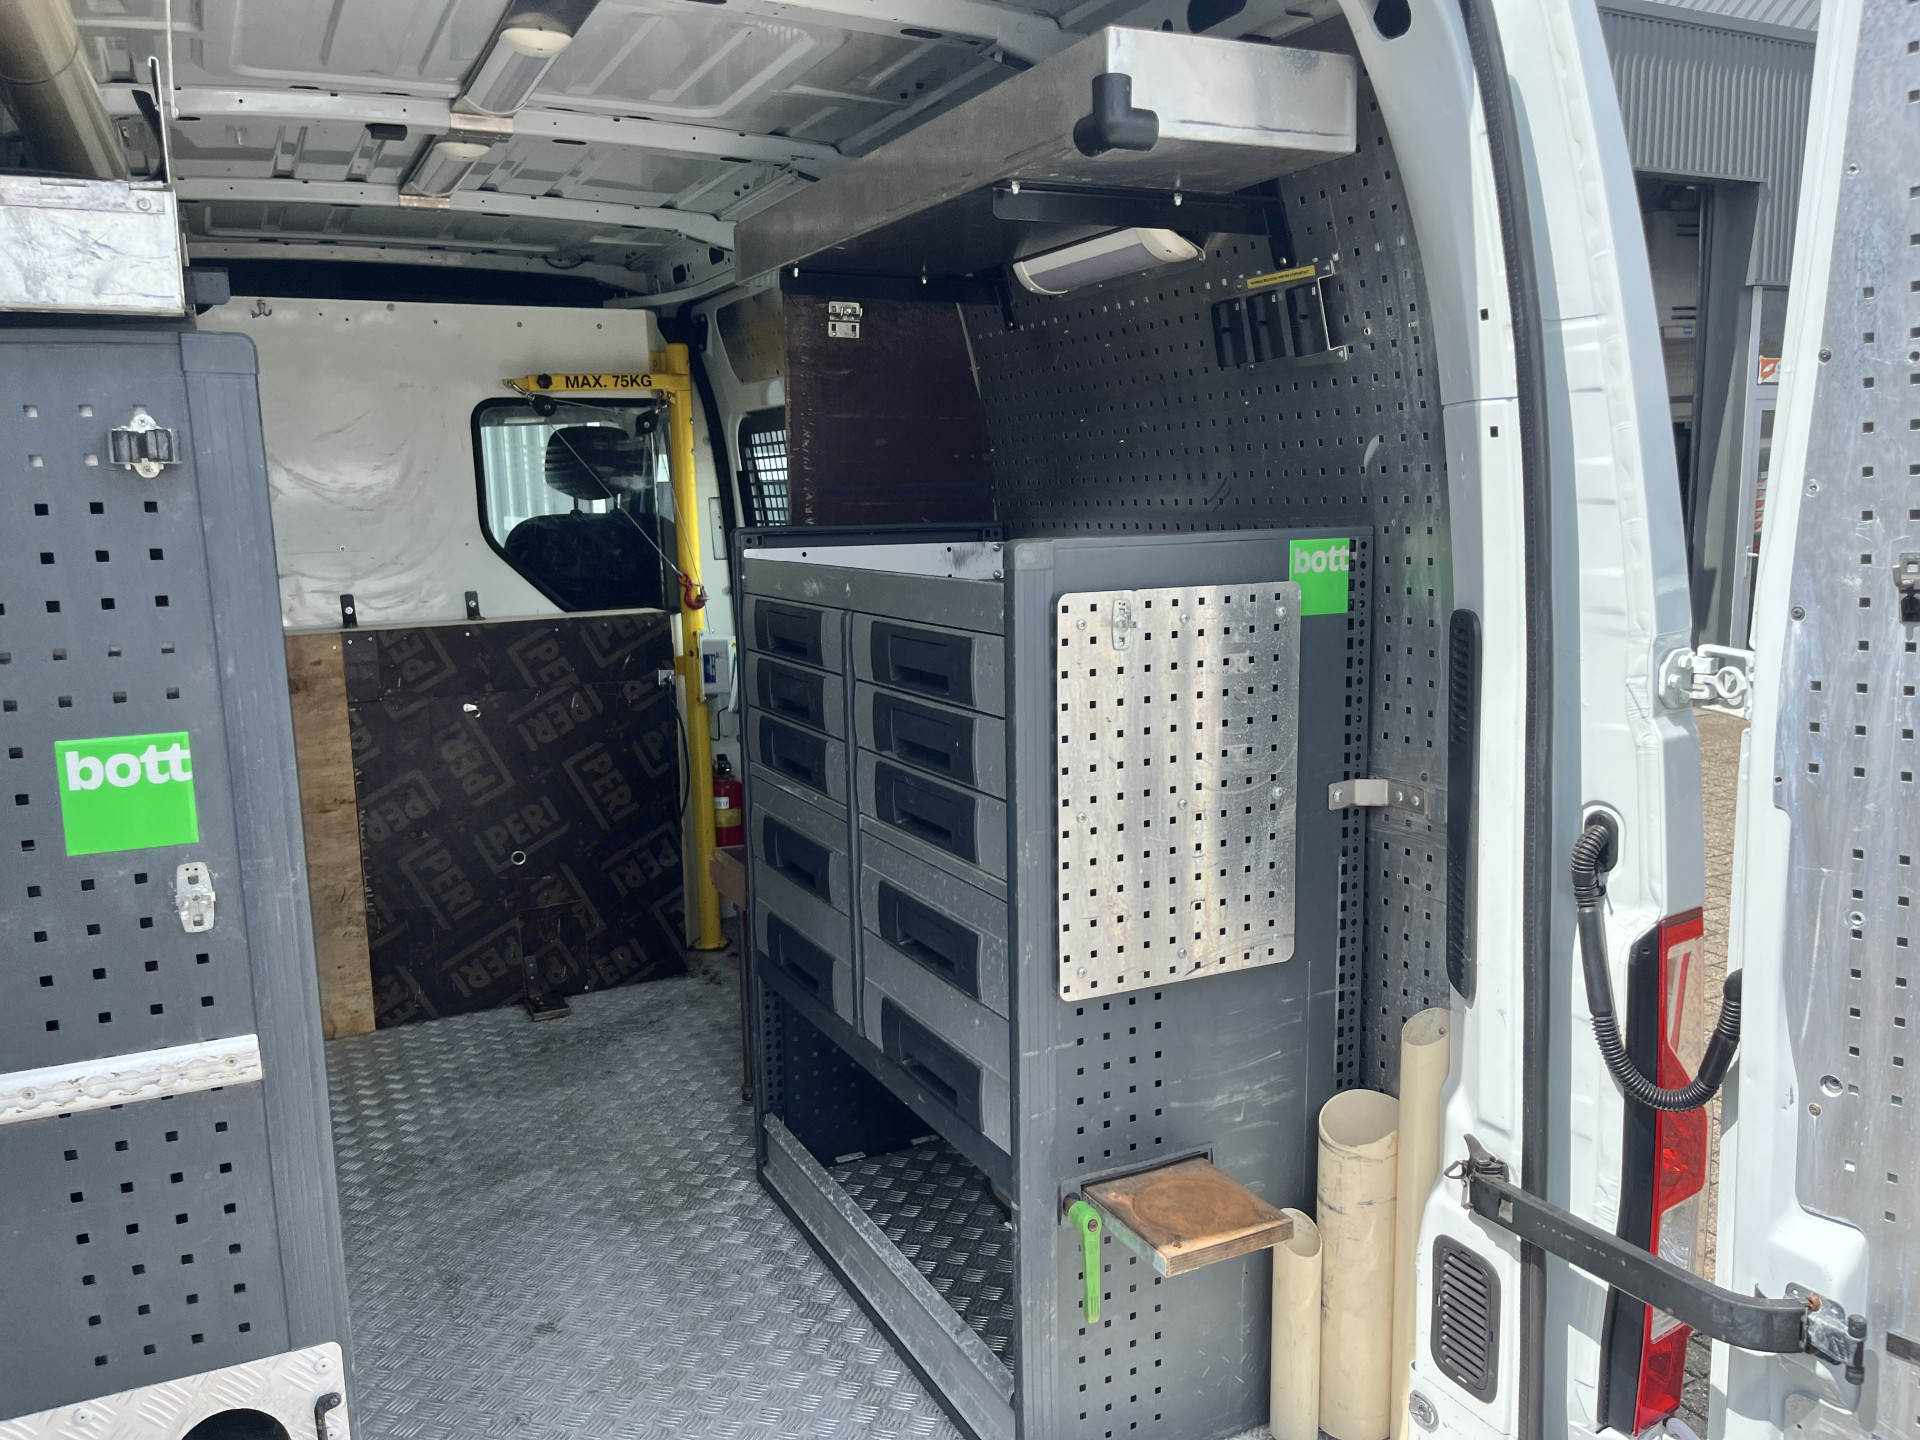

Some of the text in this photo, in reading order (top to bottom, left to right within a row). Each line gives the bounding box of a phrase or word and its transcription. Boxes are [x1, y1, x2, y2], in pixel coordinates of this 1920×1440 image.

[565, 374, 653, 389] MAX. 75KG
[1294, 545, 1350, 574] bott
[65, 743, 193, 791] bott
[580, 752, 640, 822] PERI
[366, 788, 430, 842] PER
[485, 795, 560, 855] PERI
[418, 849, 484, 919] PERI
[609, 837, 680, 897] PERI
